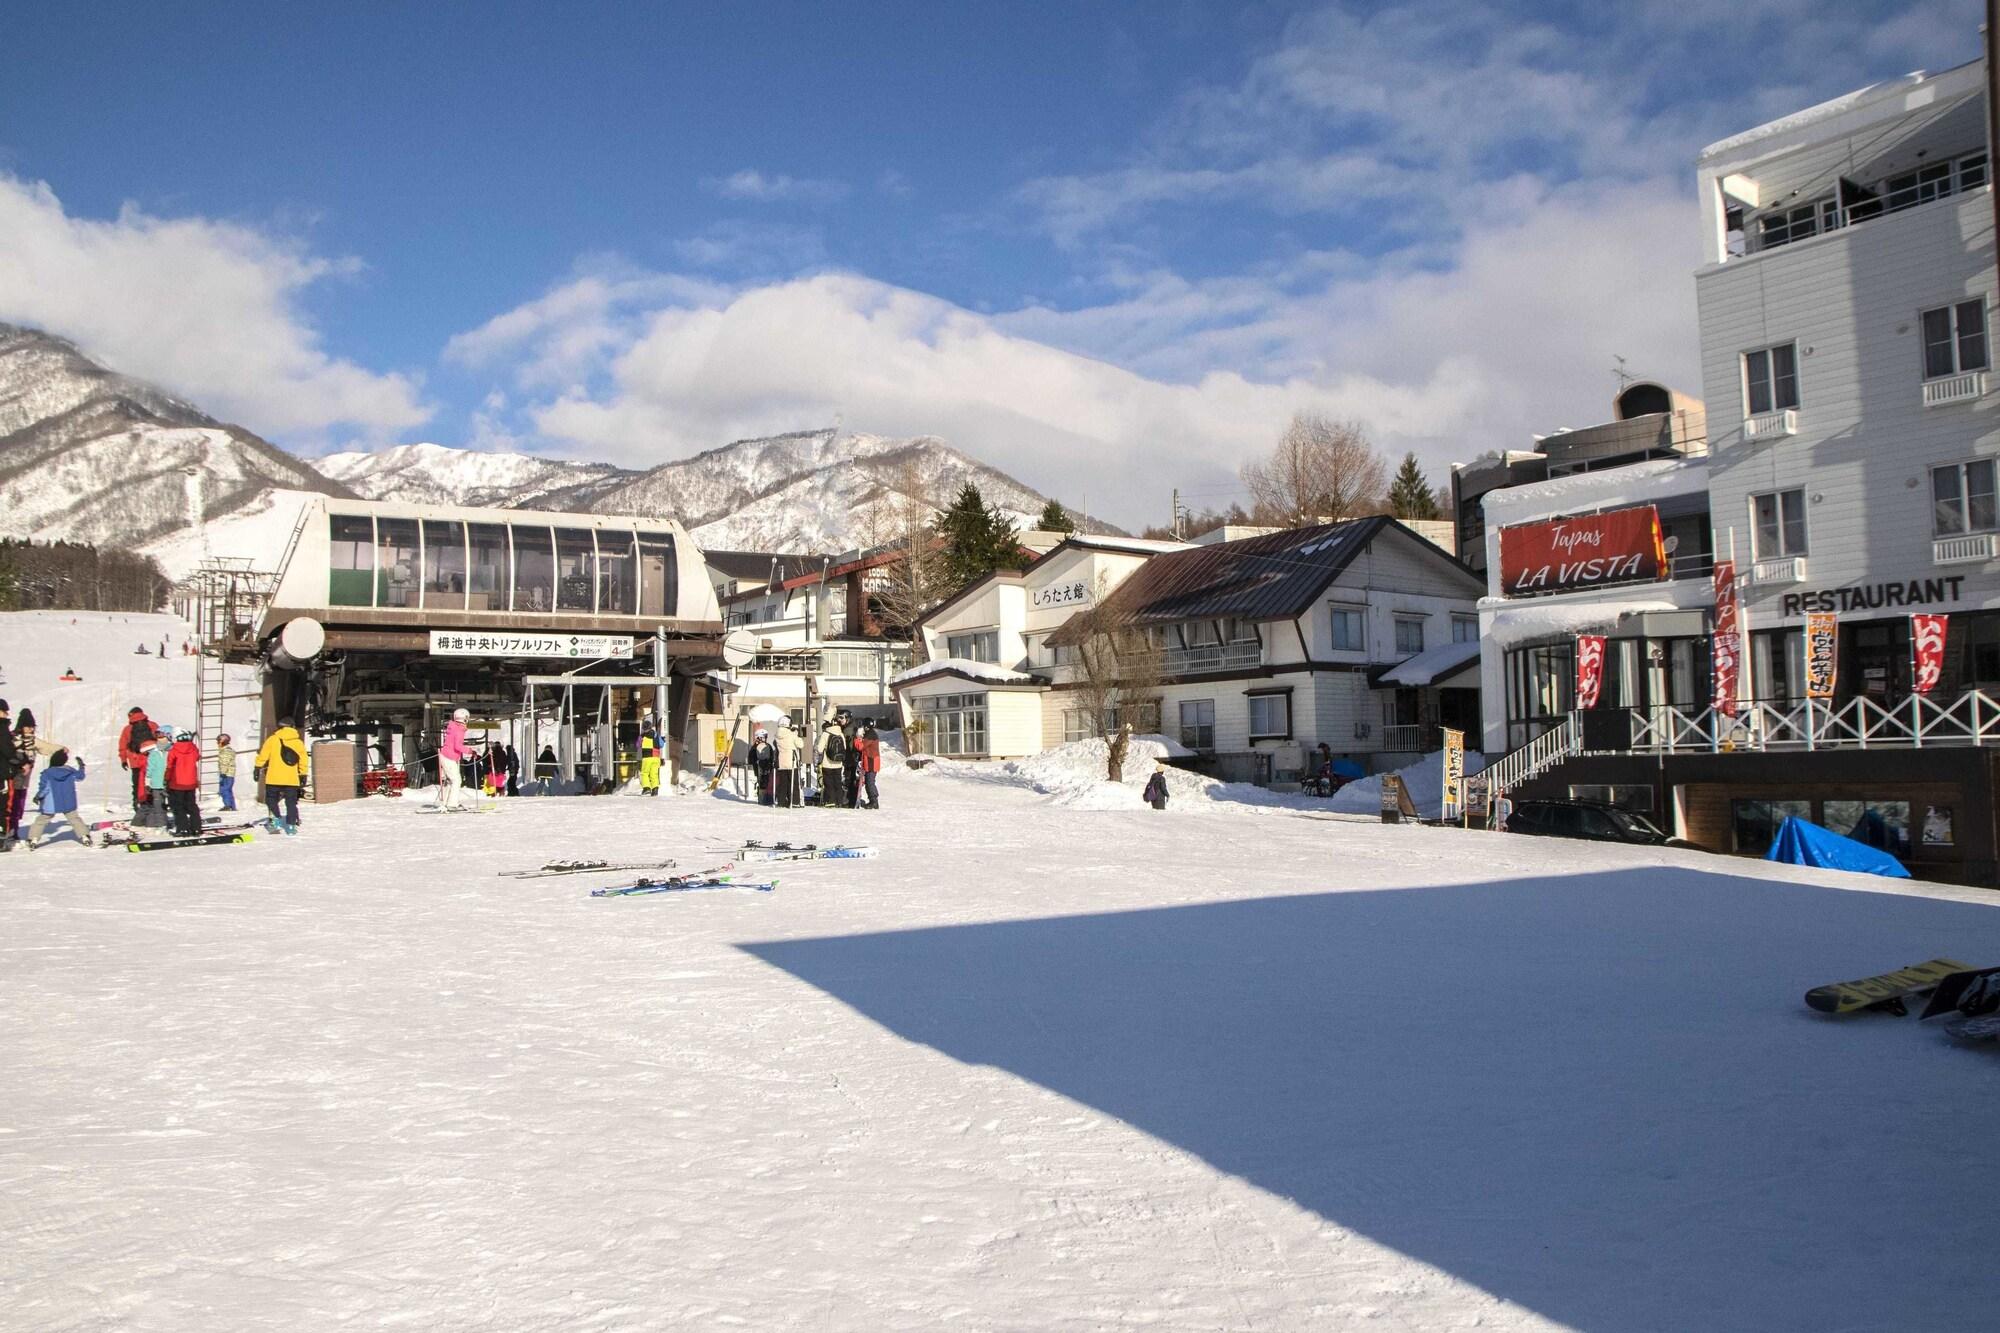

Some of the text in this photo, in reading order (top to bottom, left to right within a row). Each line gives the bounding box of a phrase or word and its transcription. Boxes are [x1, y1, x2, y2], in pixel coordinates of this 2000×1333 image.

[1551, 525, 1605, 555] Tapas
[1515, 552, 1643, 589] LA VISTA
[1033, 583, 1084, 606] しろたえ館
[1783, 575, 1965, 617] RESTAURANT
[438, 636, 562, 652] 栂池中央トリプルリフト
